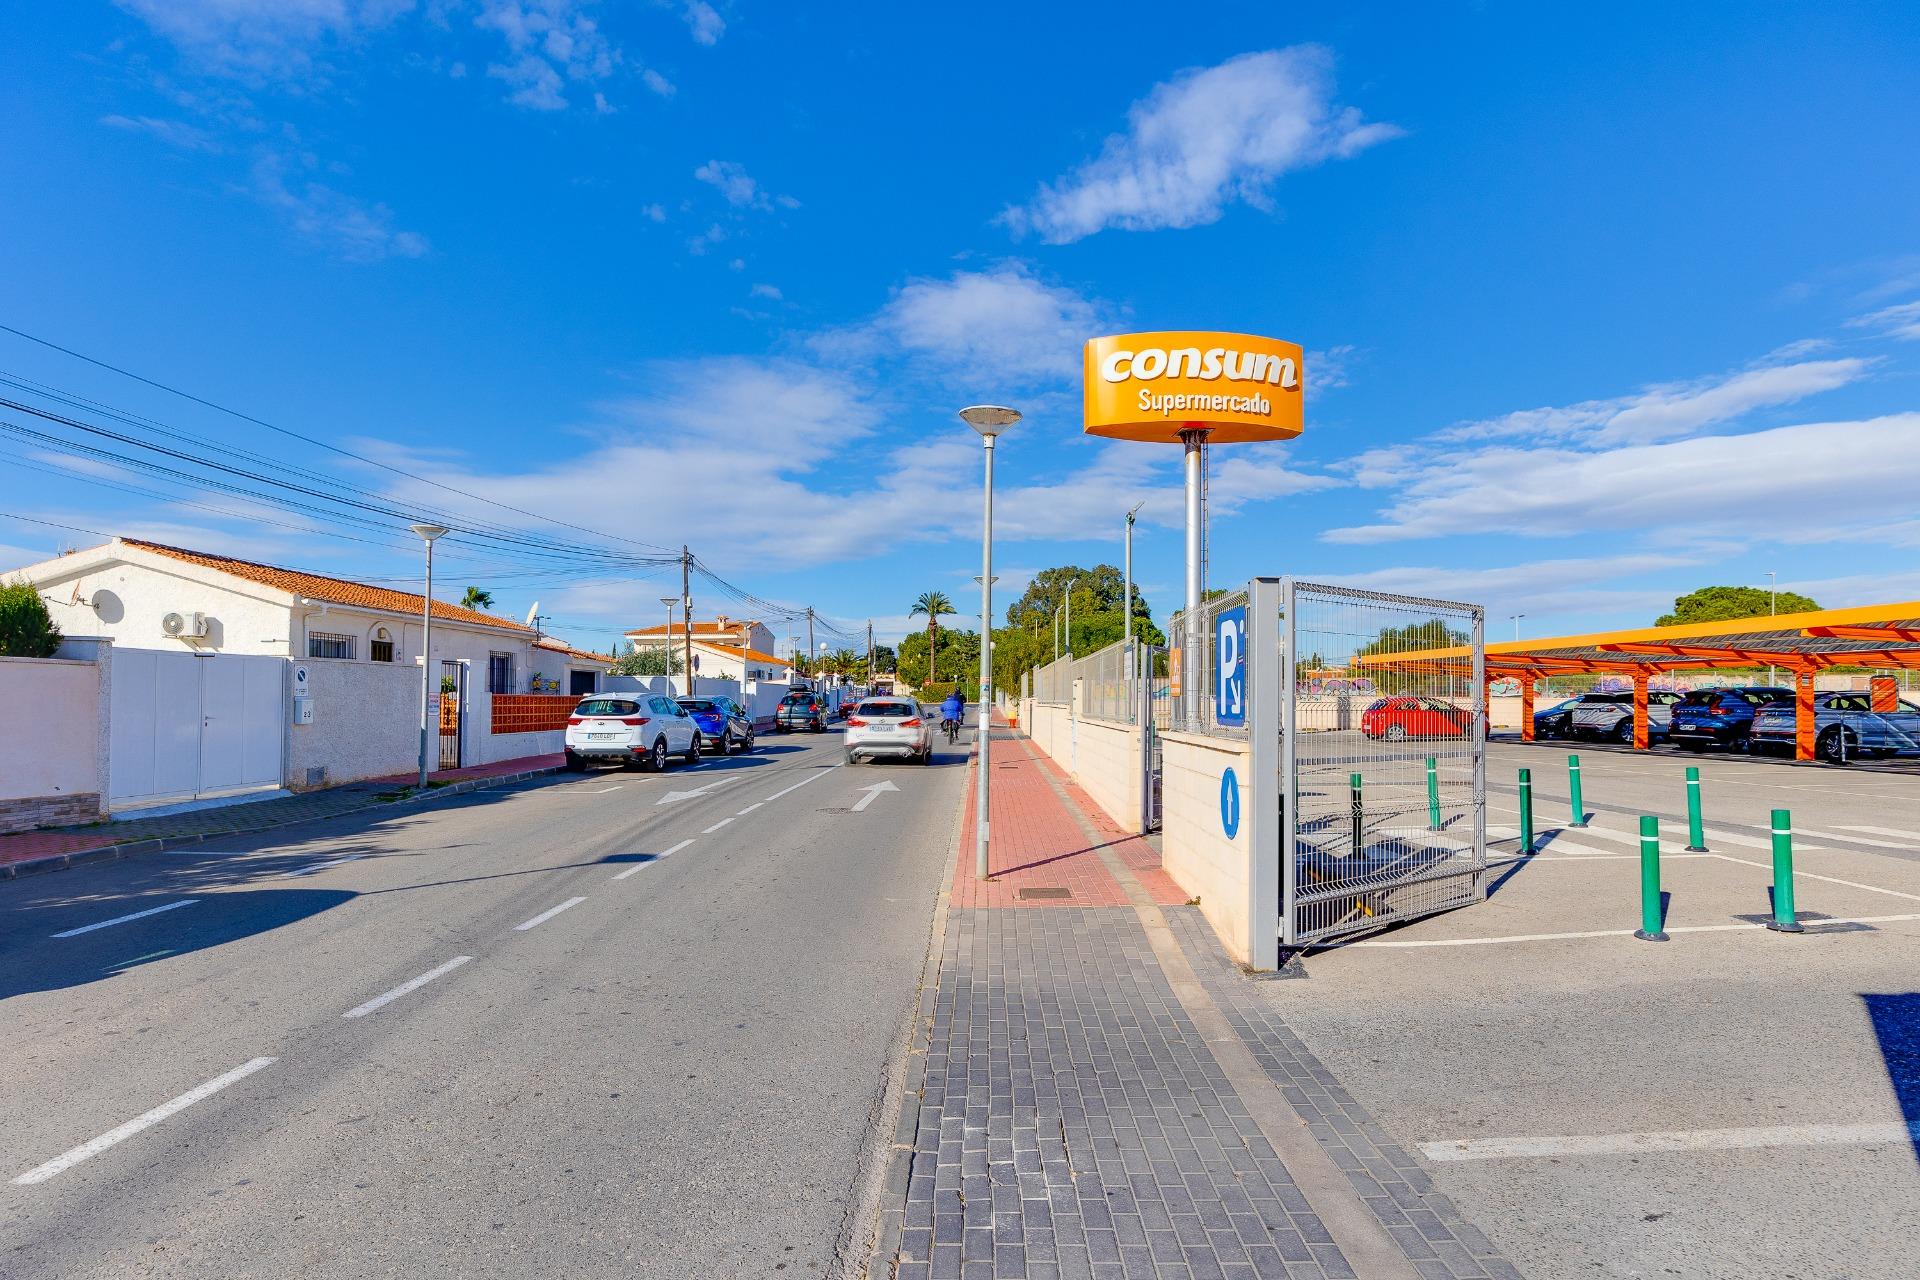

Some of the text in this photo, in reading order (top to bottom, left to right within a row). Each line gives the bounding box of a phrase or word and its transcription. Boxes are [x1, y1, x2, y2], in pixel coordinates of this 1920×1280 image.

[1101, 347, 1297, 388] consum
[1138, 388, 1271, 416] Supermercado
[1220, 619, 1238, 716] P
